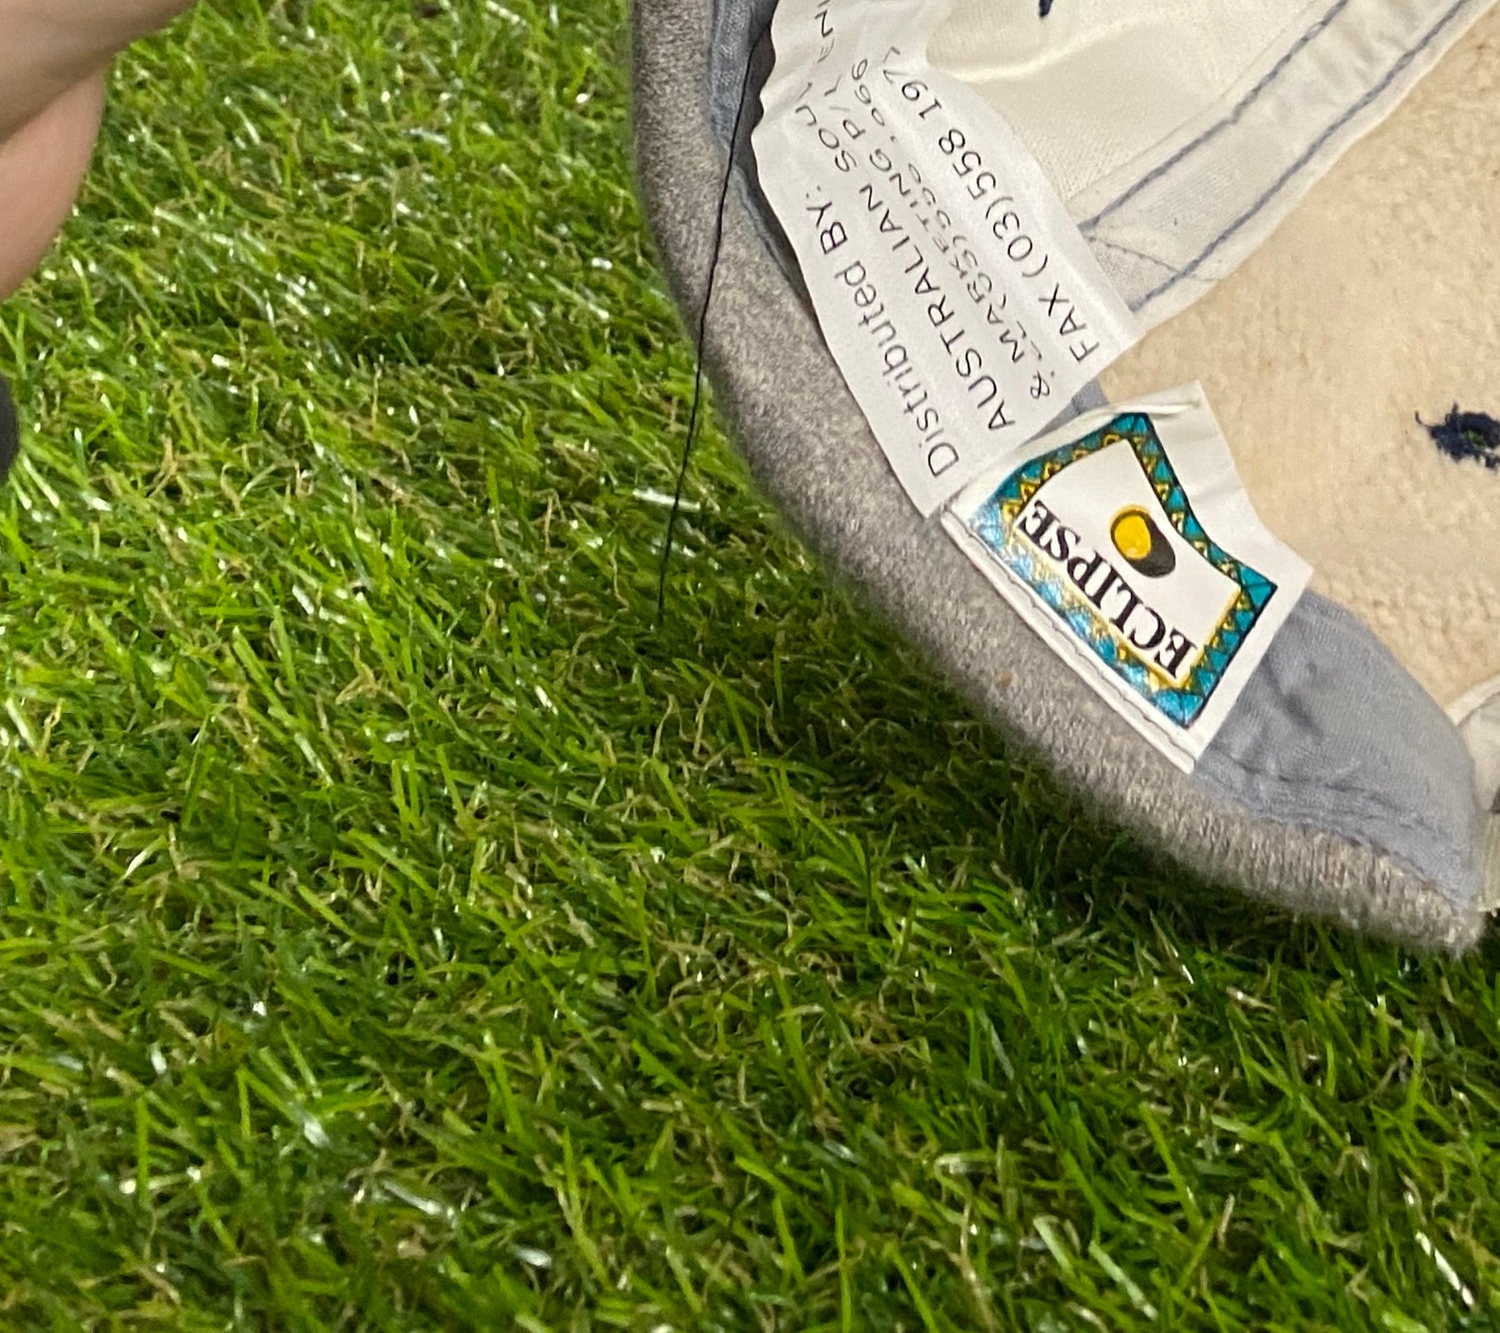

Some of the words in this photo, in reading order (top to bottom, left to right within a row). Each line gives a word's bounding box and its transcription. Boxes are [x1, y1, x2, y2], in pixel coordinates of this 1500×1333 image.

[805, 185, 848, 255] BY:
[937, 128, 1049, 278] (03)558
[834, 259, 960, 478] Distributed
[858, 183, 1016, 431] AUSTRALIAN
[1038, 282, 1100, 363] FAX
[1029, 370, 1051, 400] &
[1018, 499, 1199, 680] ECLIPSE
